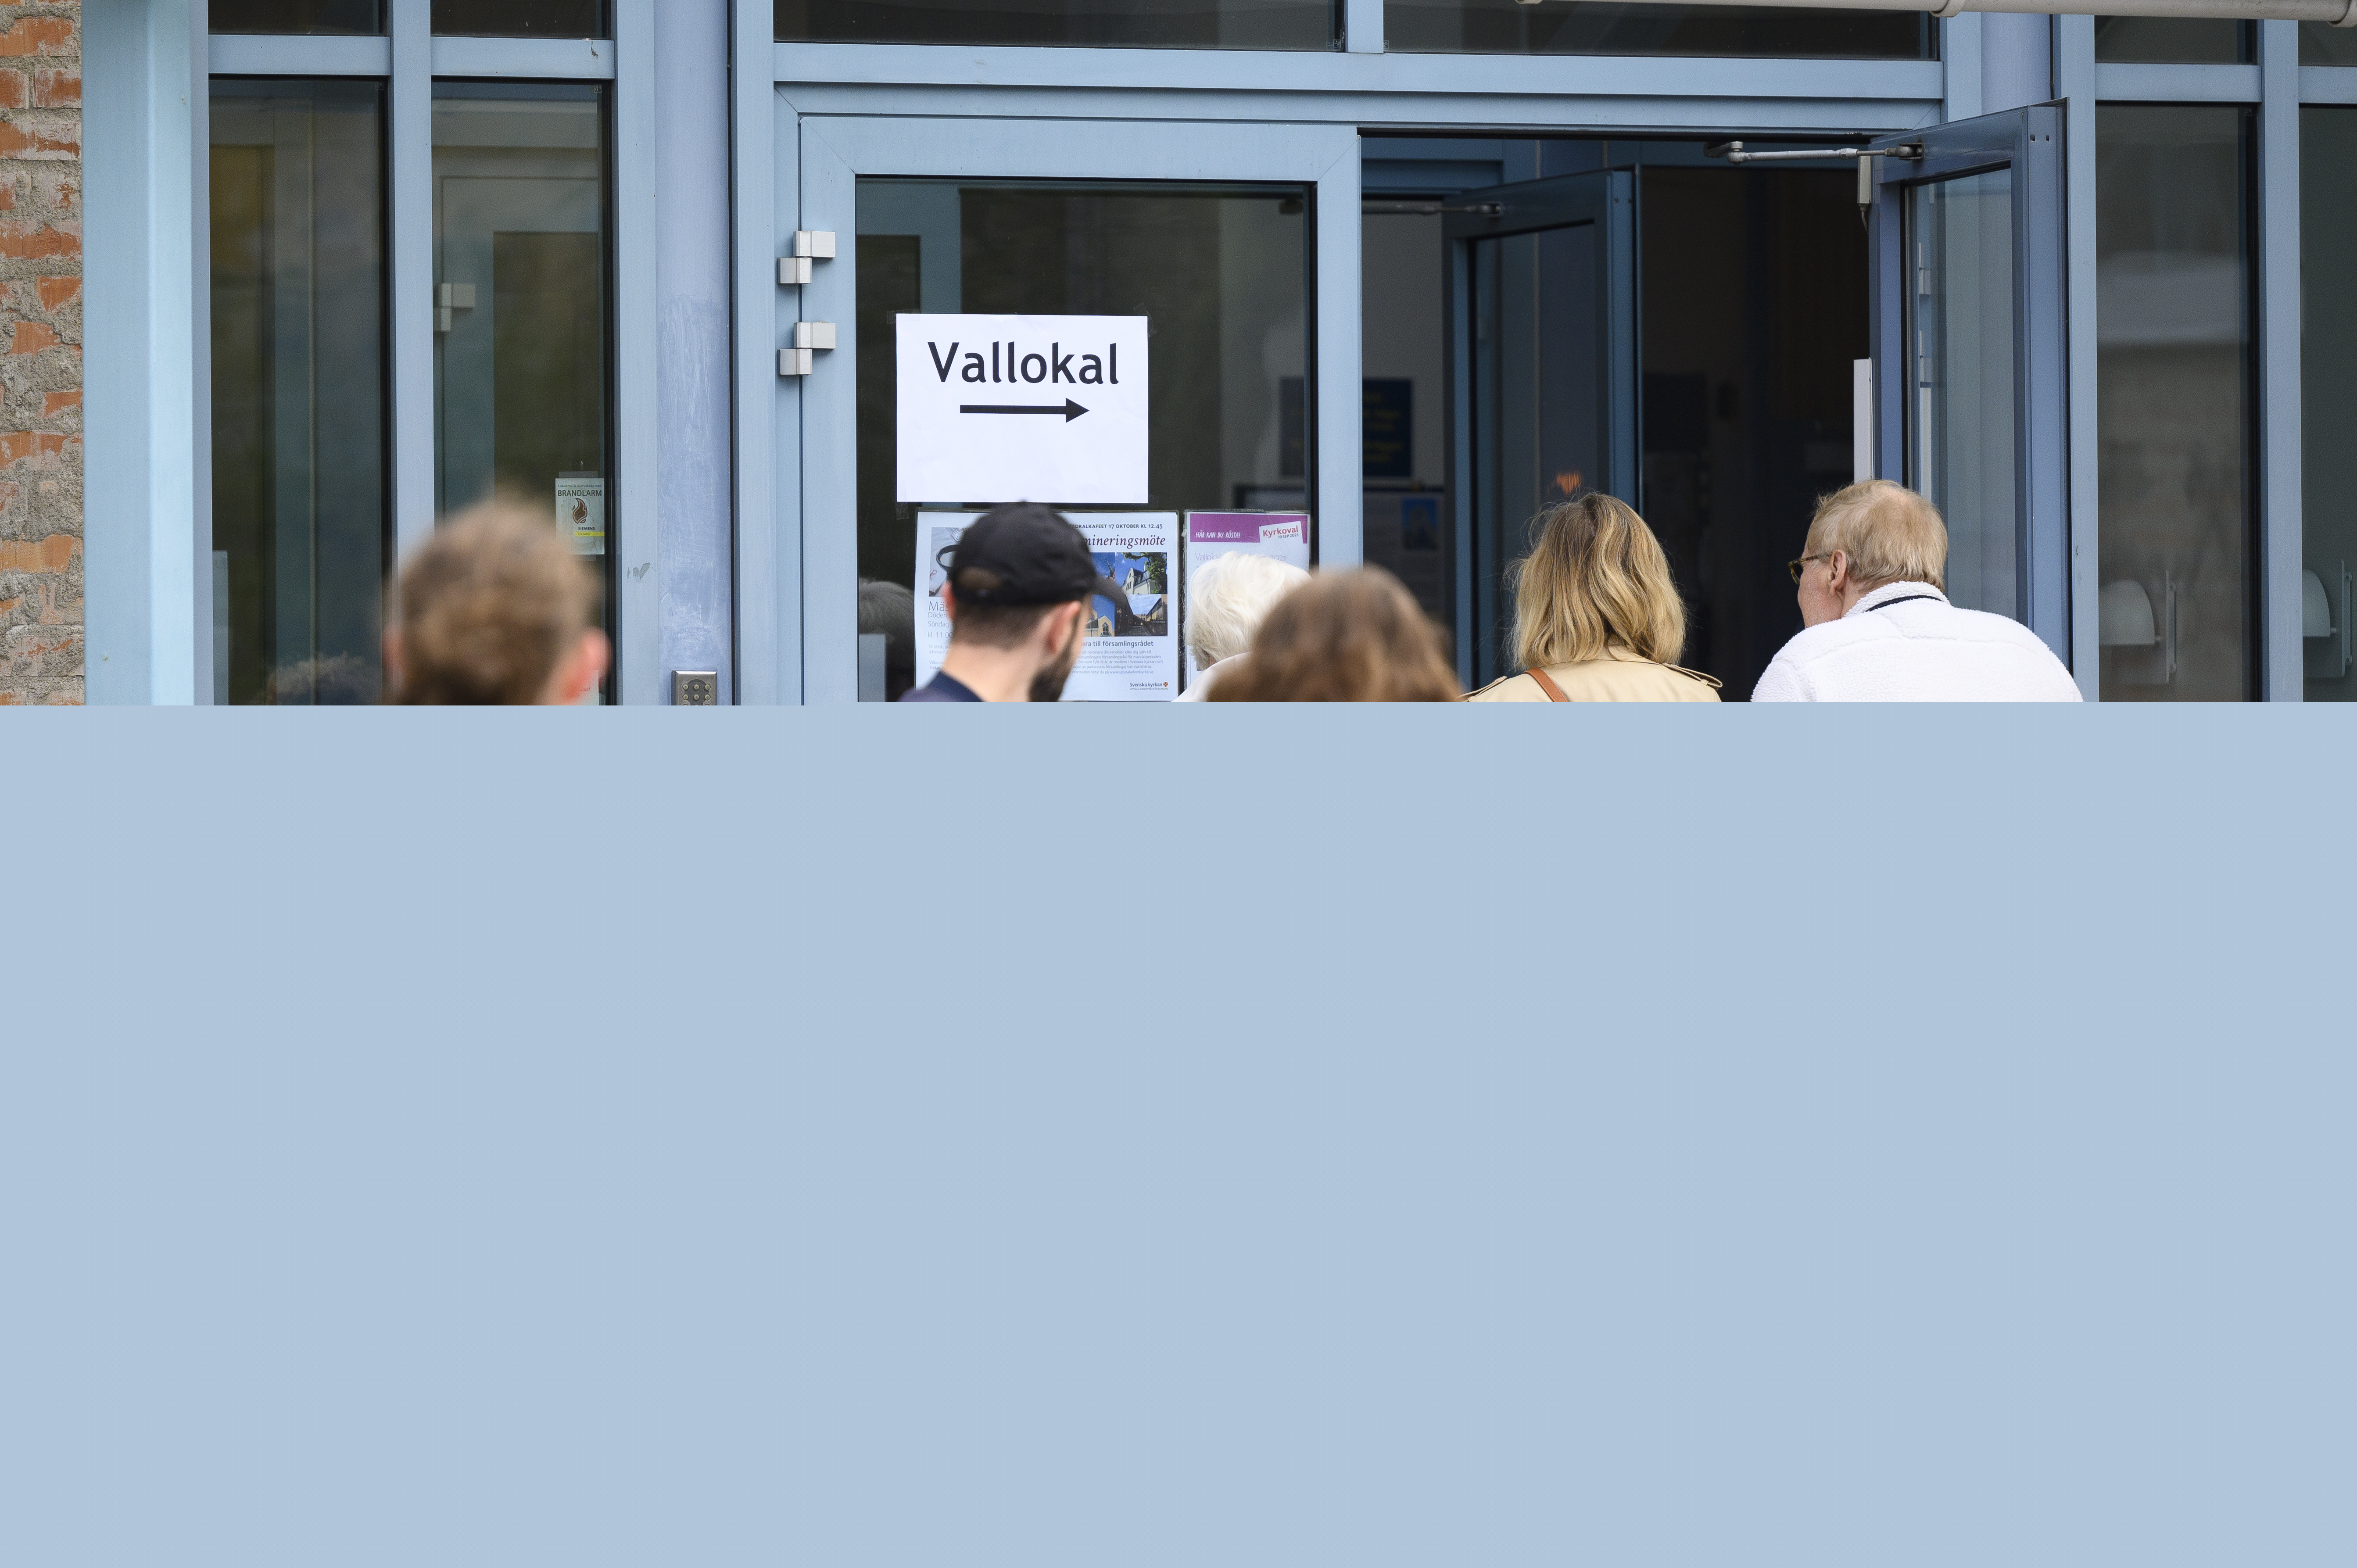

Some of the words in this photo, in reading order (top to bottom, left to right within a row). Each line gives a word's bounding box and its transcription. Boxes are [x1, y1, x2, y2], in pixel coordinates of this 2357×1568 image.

[927, 341, 1119, 385] Vallokal
[1195, 530, 1205, 538] HÄR
[1225, 530, 1241, 538] RÖSTA!
[1263, 525, 1299, 538] Kyrkoval
[1084, 534, 1166, 549] mineringsmöte
[1195, 552, 1223, 561] Vallokal
[928, 601, 949, 611] Mäs
[928, 620, 949, 629] Söndag
